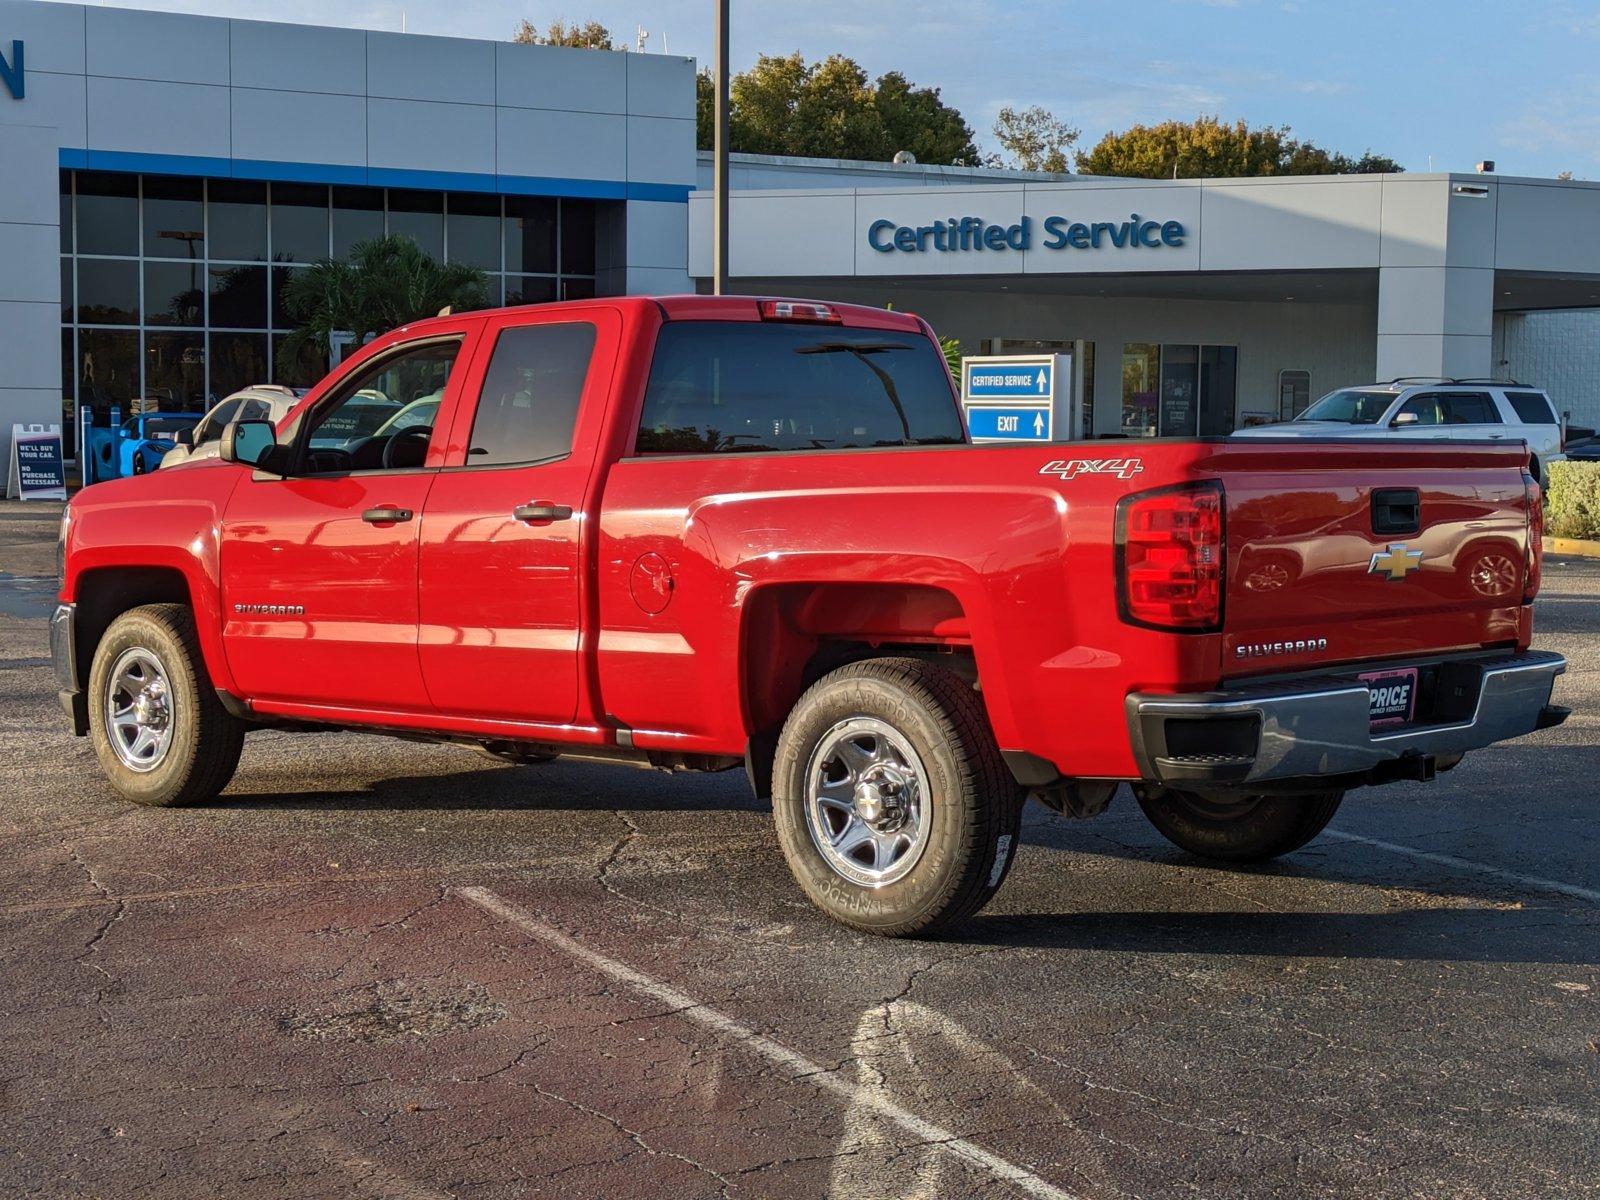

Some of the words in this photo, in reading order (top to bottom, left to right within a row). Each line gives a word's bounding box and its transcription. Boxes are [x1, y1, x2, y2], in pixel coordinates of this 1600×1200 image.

[868, 216, 1030, 251] Certified
[1043, 213, 1185, 249] Service
[972, 375, 1004, 387] CERTIFIED
[1004, 375, 1032, 386] SERVICE
[997, 416, 1019, 432] EXIT
[234, 604, 304, 615] SILVERADO
[1236, 638, 1327, 658] SILVERADO
[1369, 685, 1410, 707] PRICE
